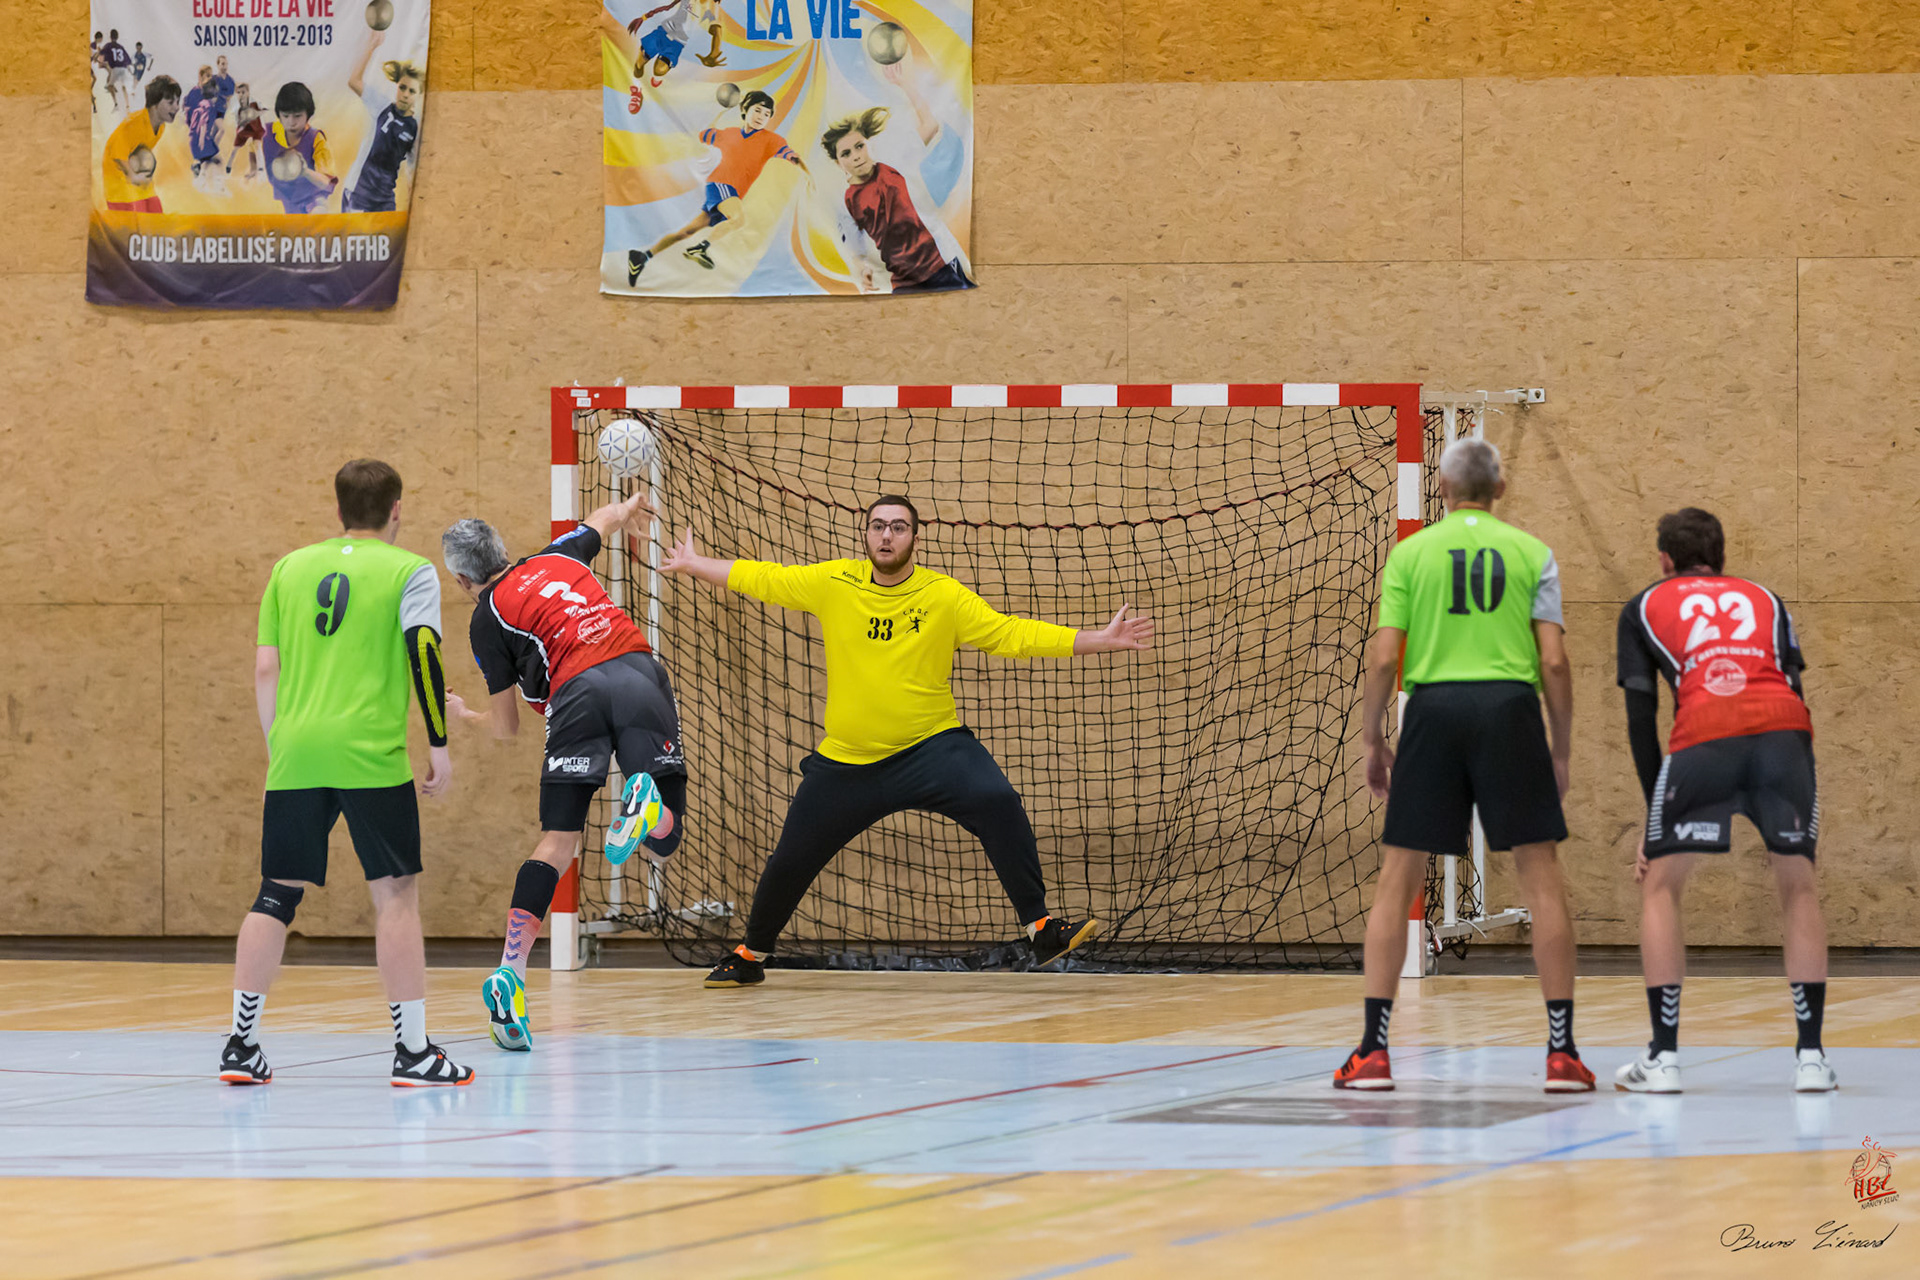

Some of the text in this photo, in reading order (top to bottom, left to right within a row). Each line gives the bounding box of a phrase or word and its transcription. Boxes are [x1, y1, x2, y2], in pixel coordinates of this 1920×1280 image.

[250, 0, 273, 18] DE
[278, 0, 300, 18] LA
[306, 0, 334, 17] VIE
[746, 0, 863, 40] LA VIE
[194, 24, 333, 46] SAISON 2012-2013
[111, 47, 124, 62] 13
[128, 231, 390, 264] CLUB LABELLISÉ PAR LA FFHB
[842, 571, 863, 584] Kempa
[1448, 547, 1506, 615] 10
[315, 572, 350, 637] 9
[867, 617, 893, 641] 33
[1679, 591, 1757, 653] 29
[562, 764, 590, 773] SPORT
[563, 756, 591, 765] INTER
